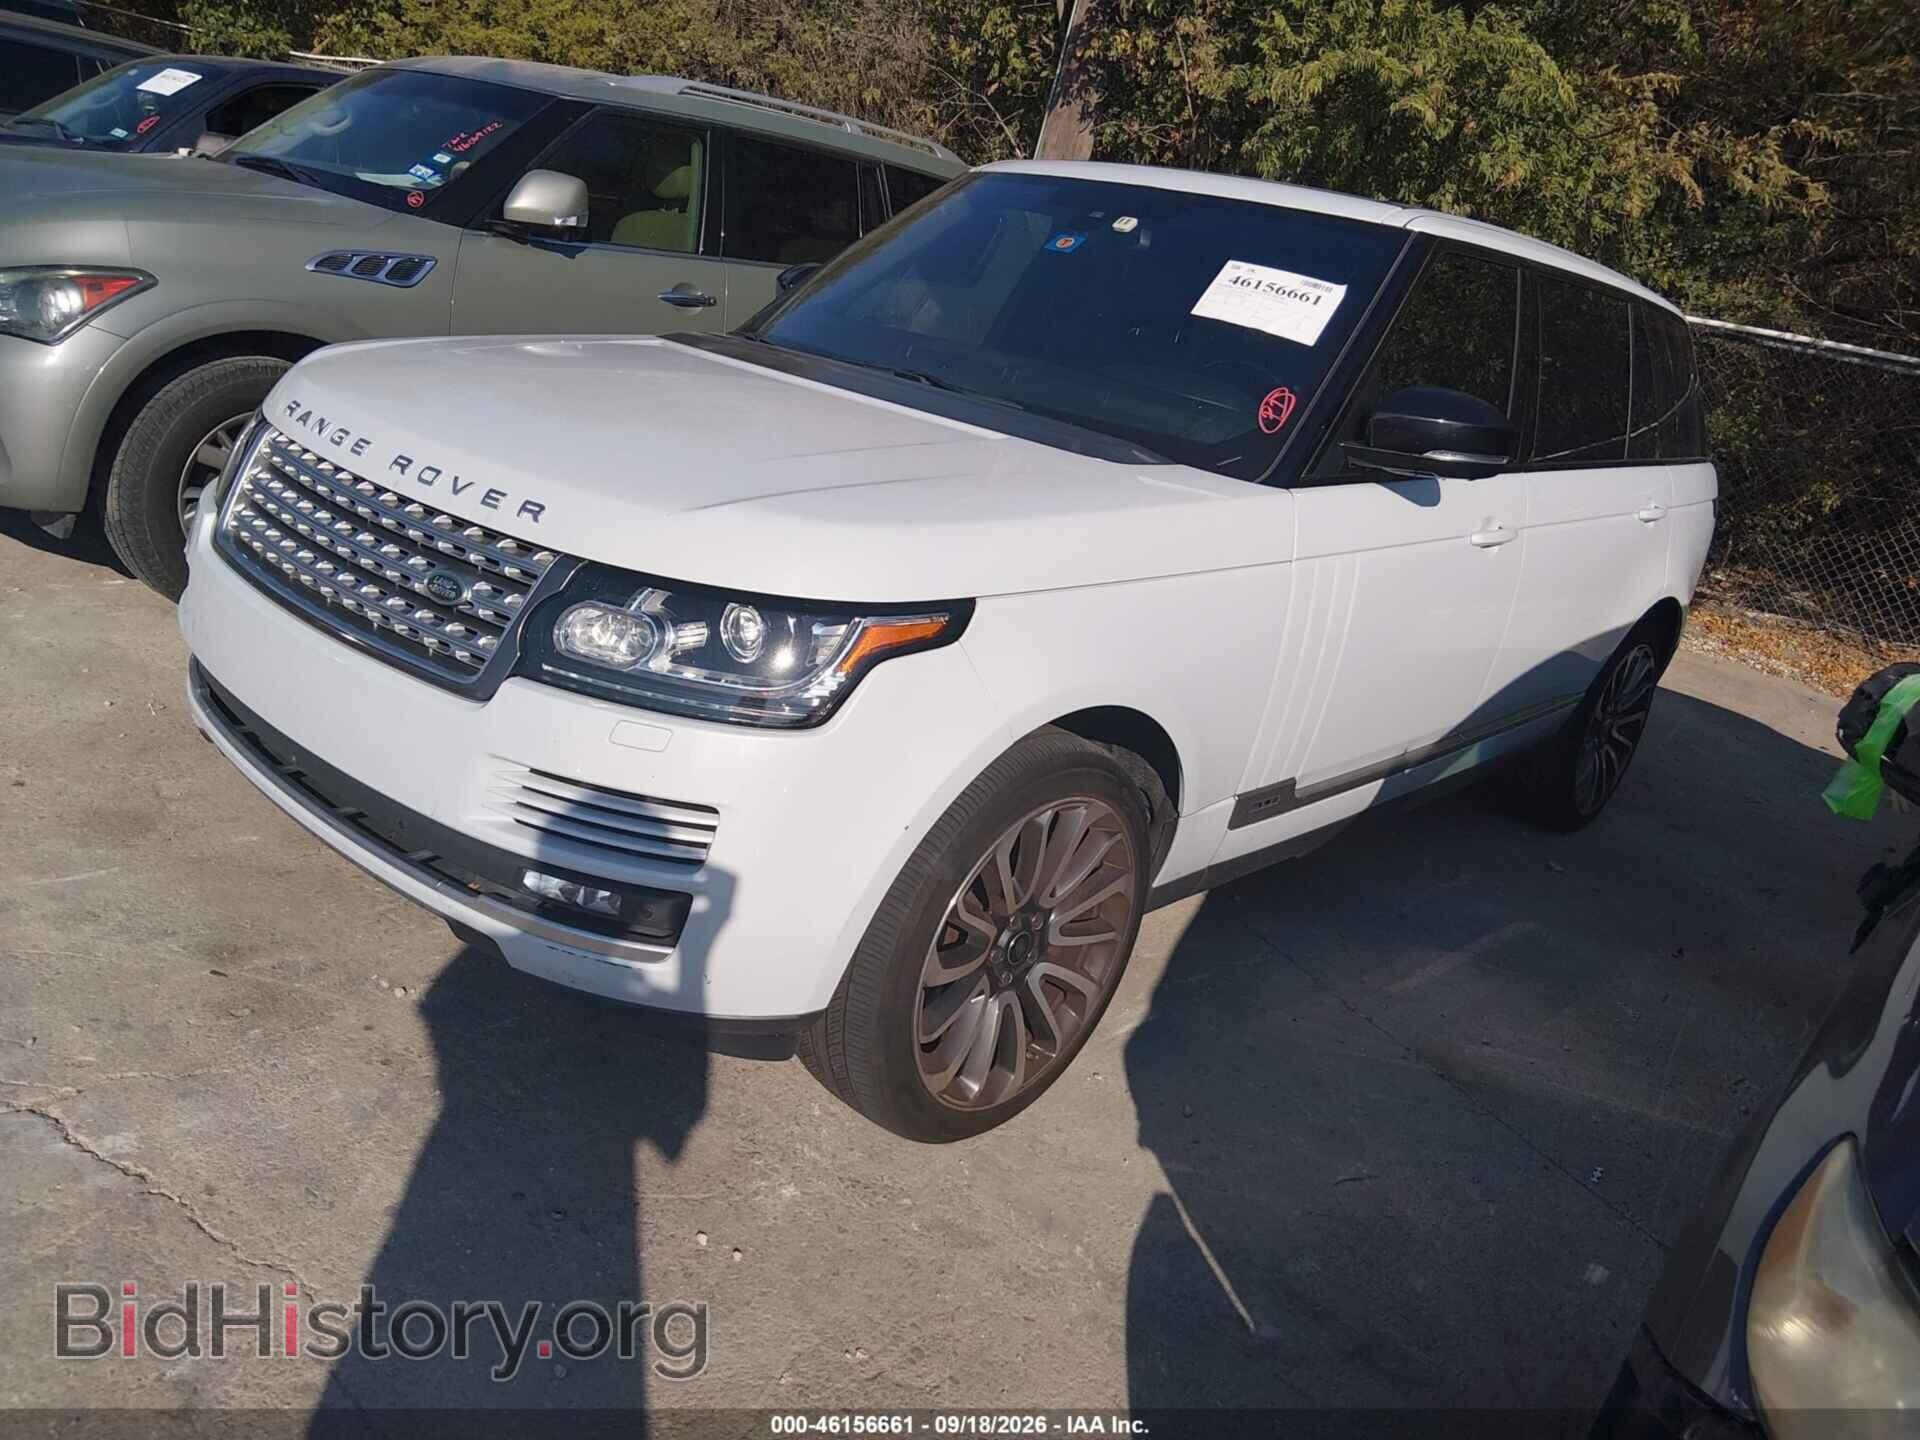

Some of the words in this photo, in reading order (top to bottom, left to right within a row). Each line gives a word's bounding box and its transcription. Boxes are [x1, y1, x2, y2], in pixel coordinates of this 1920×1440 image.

[1228, 275, 1323, 306] 46156661
[284, 400, 371, 456] RANGE
[388, 454, 546, 523] ROVER
